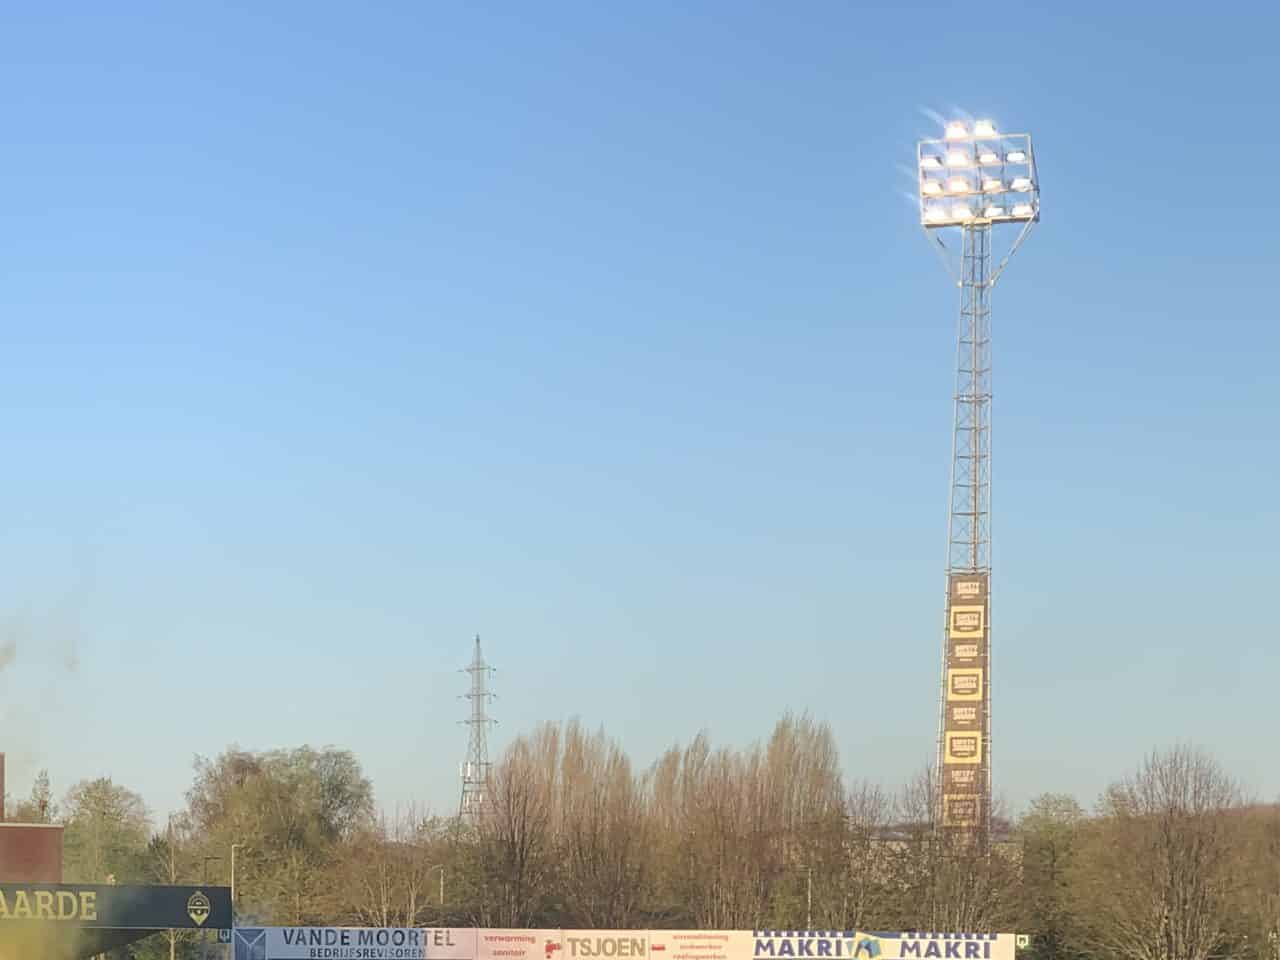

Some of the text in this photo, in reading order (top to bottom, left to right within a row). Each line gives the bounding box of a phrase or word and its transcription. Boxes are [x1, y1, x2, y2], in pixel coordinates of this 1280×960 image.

[358, 929, 456, 947] MOORTEL
[567, 938, 646, 956] TSJOEN
[310, 948, 426, 958] BEDRIJFSREVISOREN
[754, 939, 842, 957] MAKRI
[900, 940, 991, 959] MAKRI
